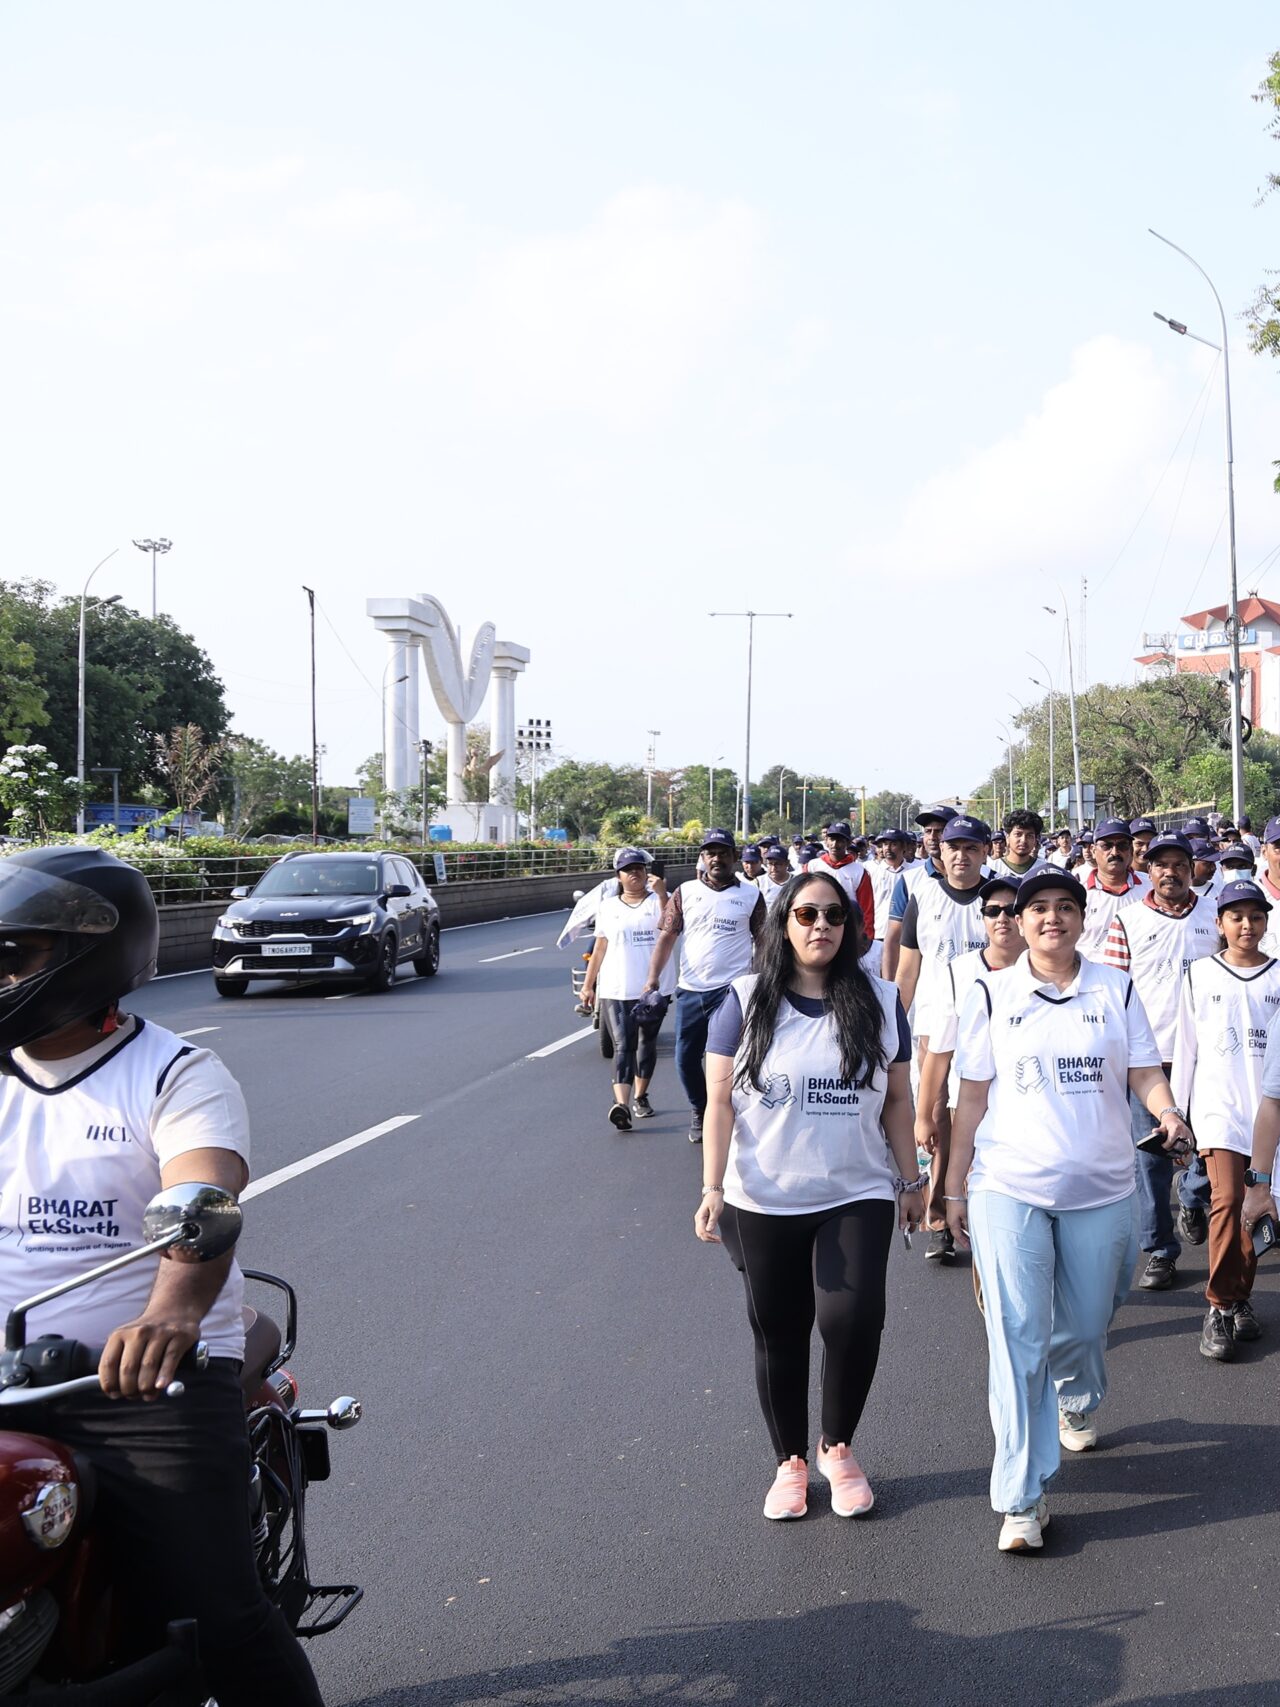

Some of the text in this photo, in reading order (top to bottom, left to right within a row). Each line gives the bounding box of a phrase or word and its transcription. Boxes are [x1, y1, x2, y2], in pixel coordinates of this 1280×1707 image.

[1057, 1056, 1106, 1070] BHARAT
[808, 1077, 861, 1091] BHARAT
[807, 1091, 859, 1105] EkSaath
[86, 1125, 132, 1142] IHCL
[28, 1196, 119, 1218] BHARAT
[25, 1245, 55, 1253] Igniting
[71, 1244, 92, 1252] spirit
[104, 1241, 132, 1249] Tajness
